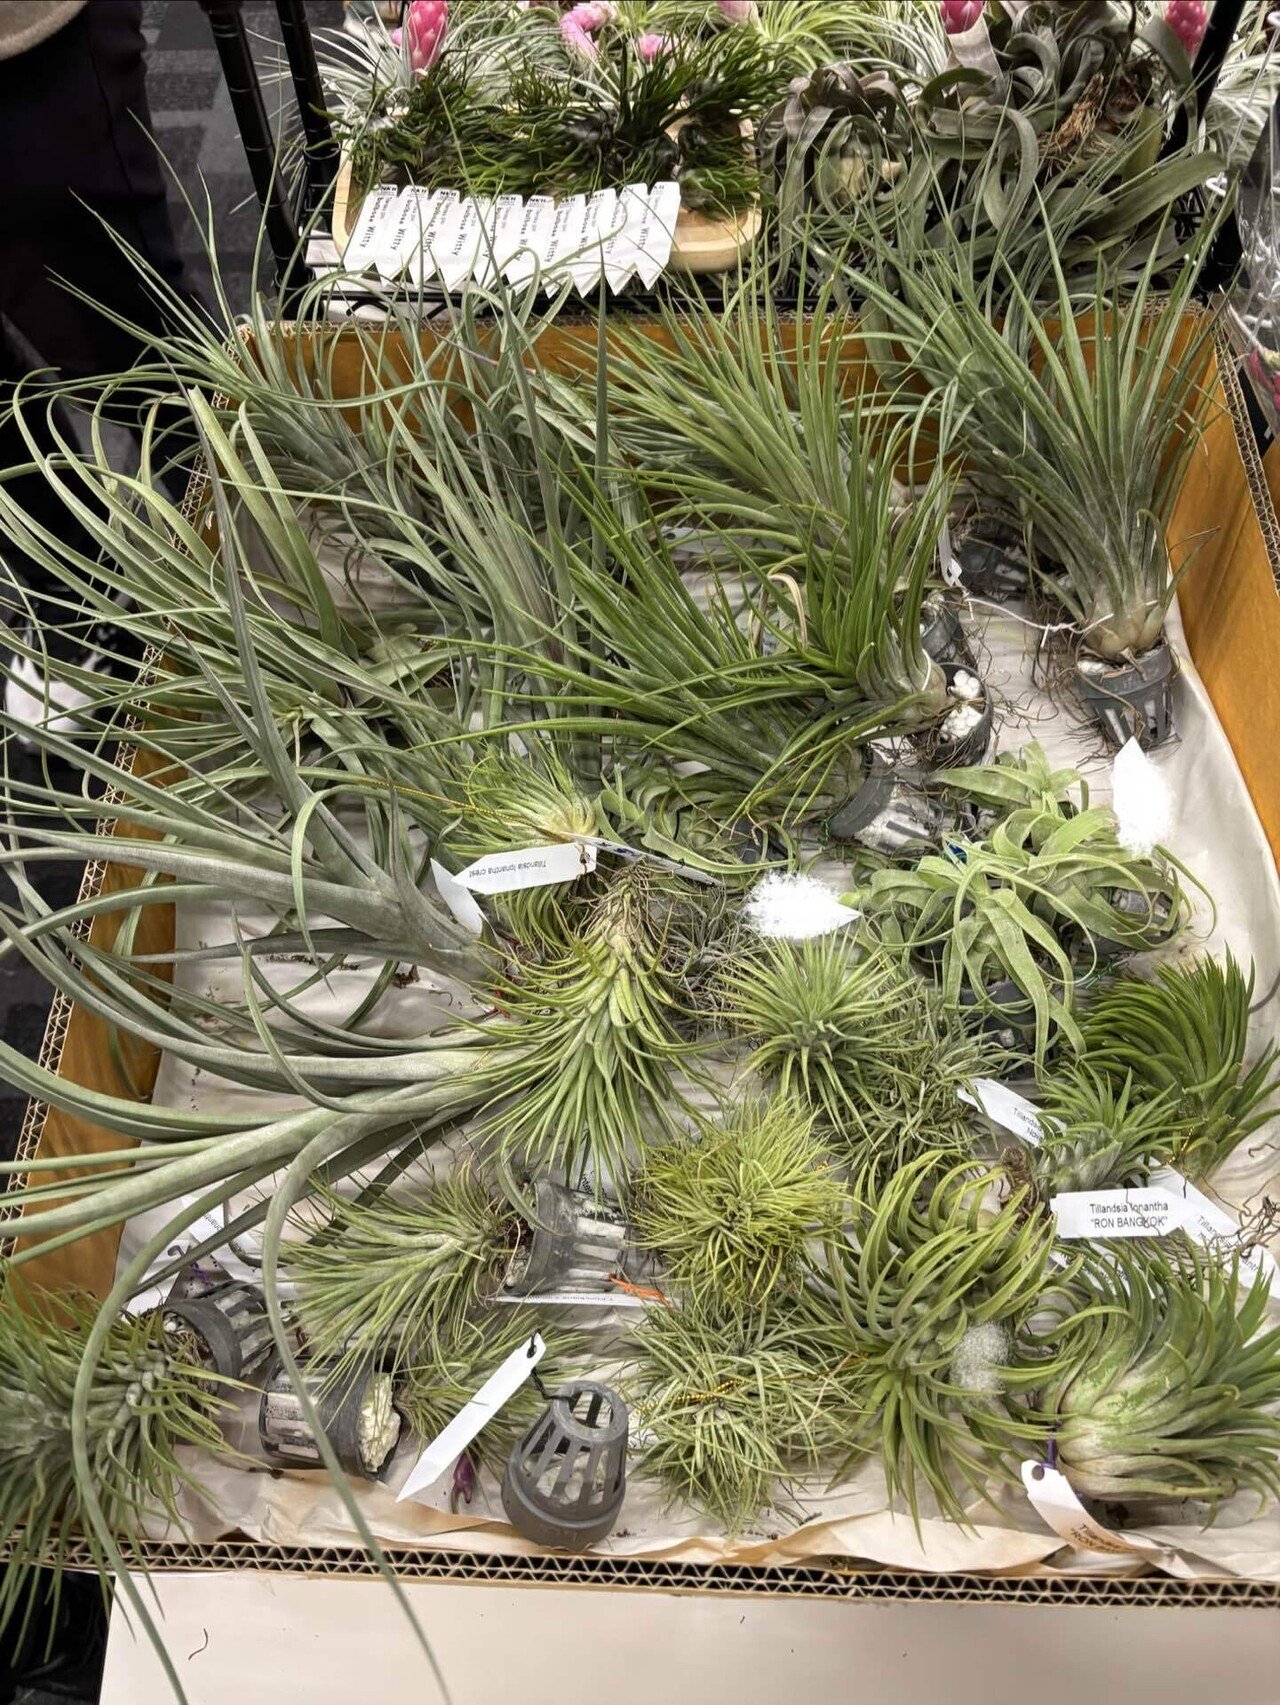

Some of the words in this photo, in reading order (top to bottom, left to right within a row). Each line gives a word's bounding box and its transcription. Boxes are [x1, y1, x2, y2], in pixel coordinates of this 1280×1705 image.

[359, 225, 376, 248] Witty
[390, 228, 407, 250] Witty
[451, 233, 468, 256] Witty
[544, 239, 560, 262] Witty
[469, 868, 487, 878] crest
[1089, 1203, 1128, 1213] Tillandsia
